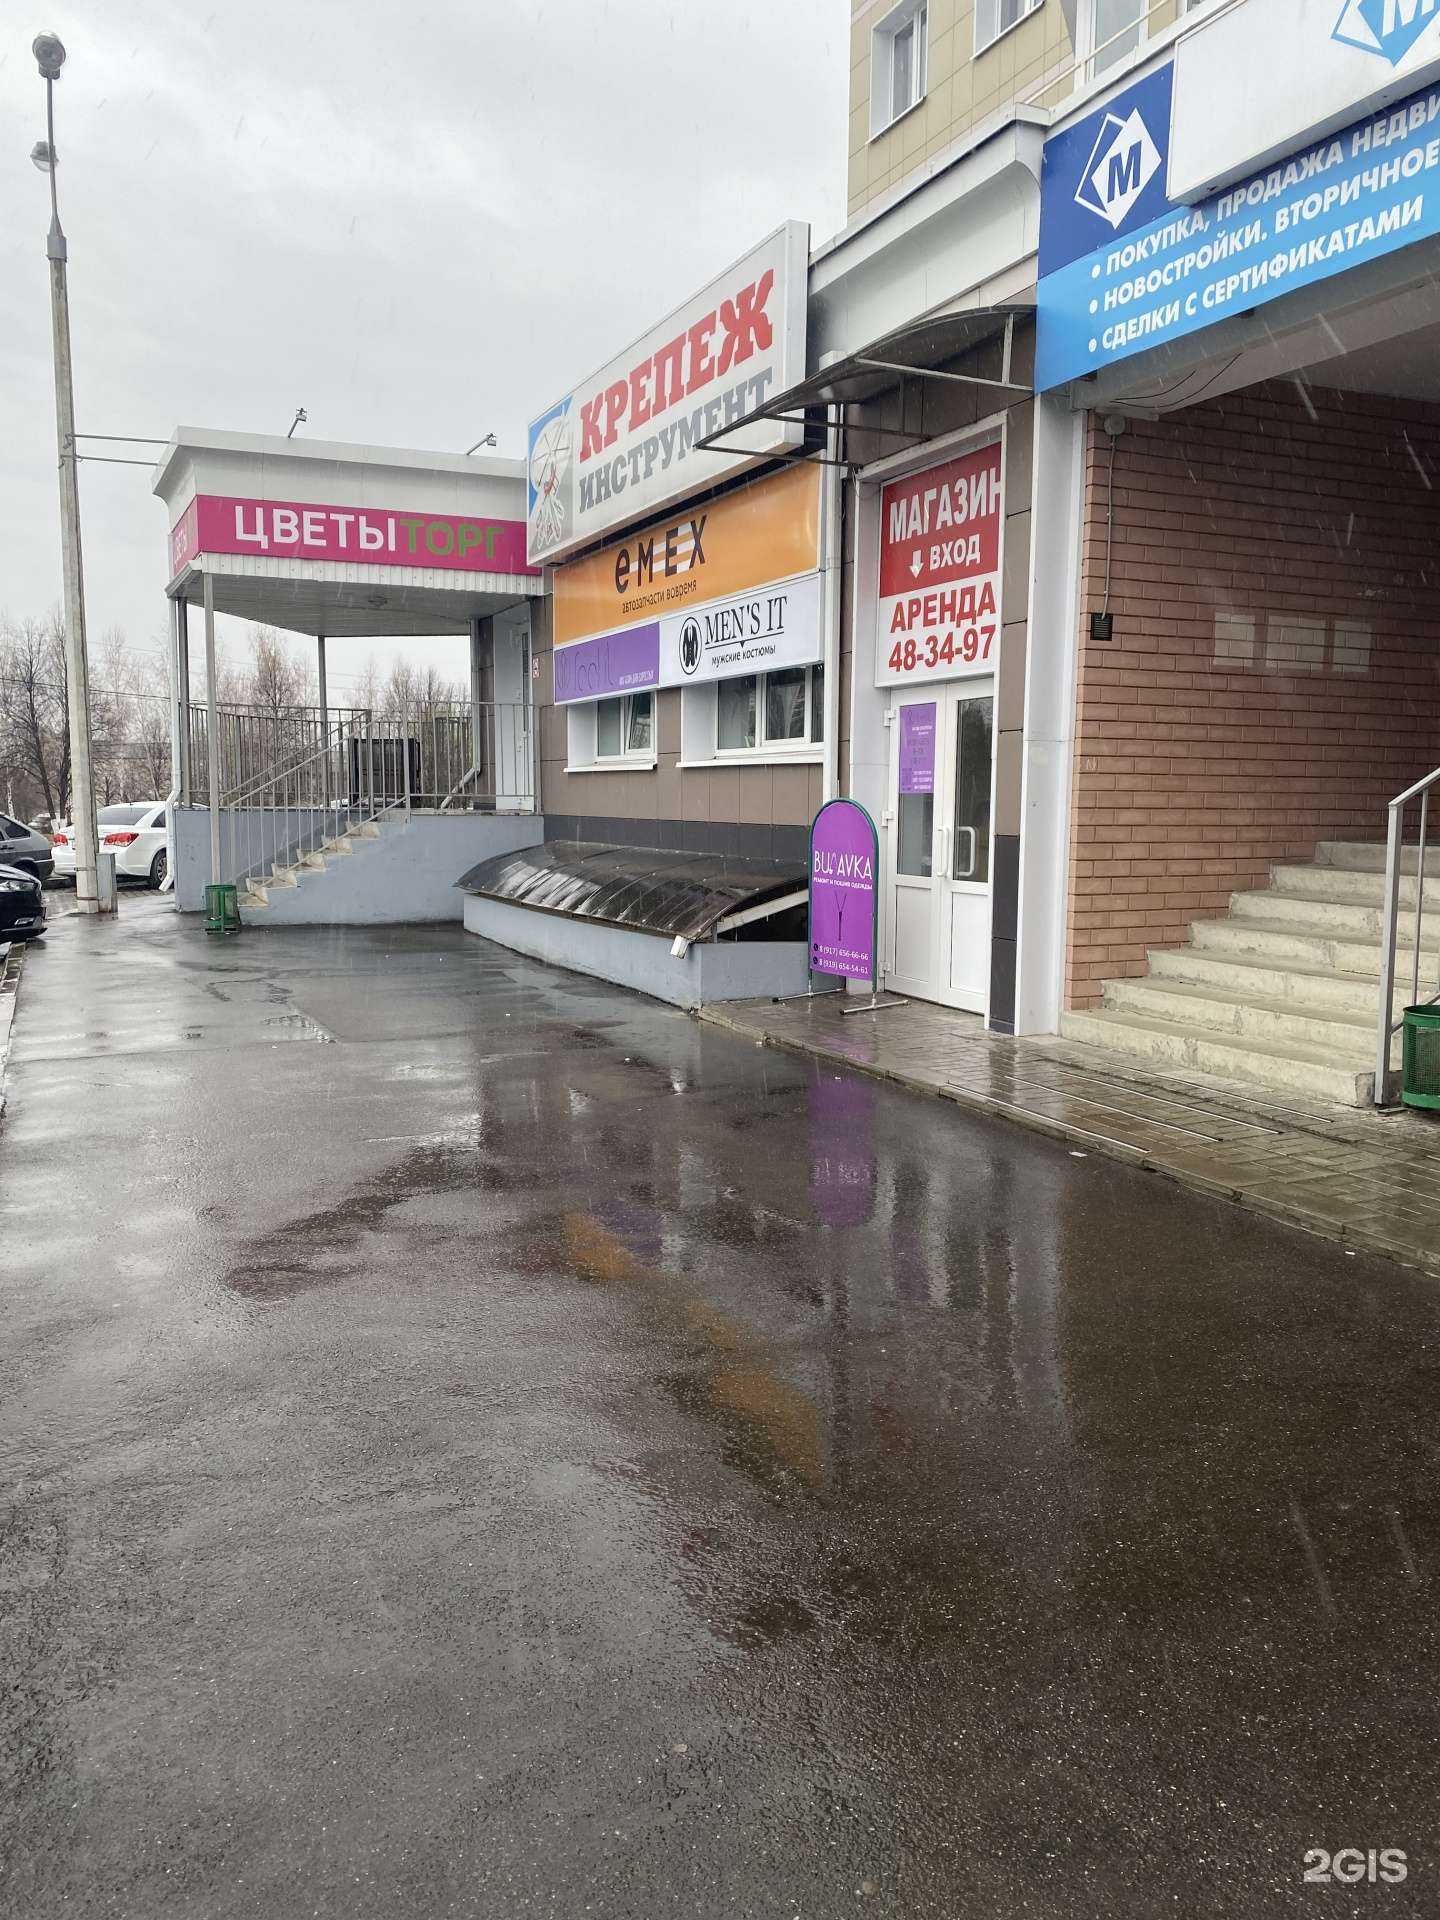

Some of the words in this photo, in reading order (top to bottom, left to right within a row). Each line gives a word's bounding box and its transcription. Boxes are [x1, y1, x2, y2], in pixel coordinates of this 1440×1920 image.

[1103, 217, 1268, 312] НОВОСТРОЙКИ.
[1274, 139, 1440, 234] ВТОРИЧНОЕ
[1106, 208, 1210, 275] ПОКУПКА,
[1216, 142, 1344, 222] ПРОДАЖА
[1101, 303, 1180, 351] СДЕЛКИ
[1184, 293, 1197, 316] С
[1202, 195, 1424, 308] СЕРТИФИКАТАМИ
[579, 268, 774, 464] КРЕПЕЖ
[579, 366, 773, 514] ИНСТРУМЕНТ
[889, 467, 1001, 544] МАГАЗИН
[929, 534, 981, 571] ВХОД
[622, 590, 665, 614] автозапчасти
[666, 579, 697, 601] вовремя
[705, 602, 760, 645] MEN'S
[767, 596, 788, 631] IT
[890, 581, 996, 633] АРЕНДА
[888, 624, 996, 673] 48-34-97
